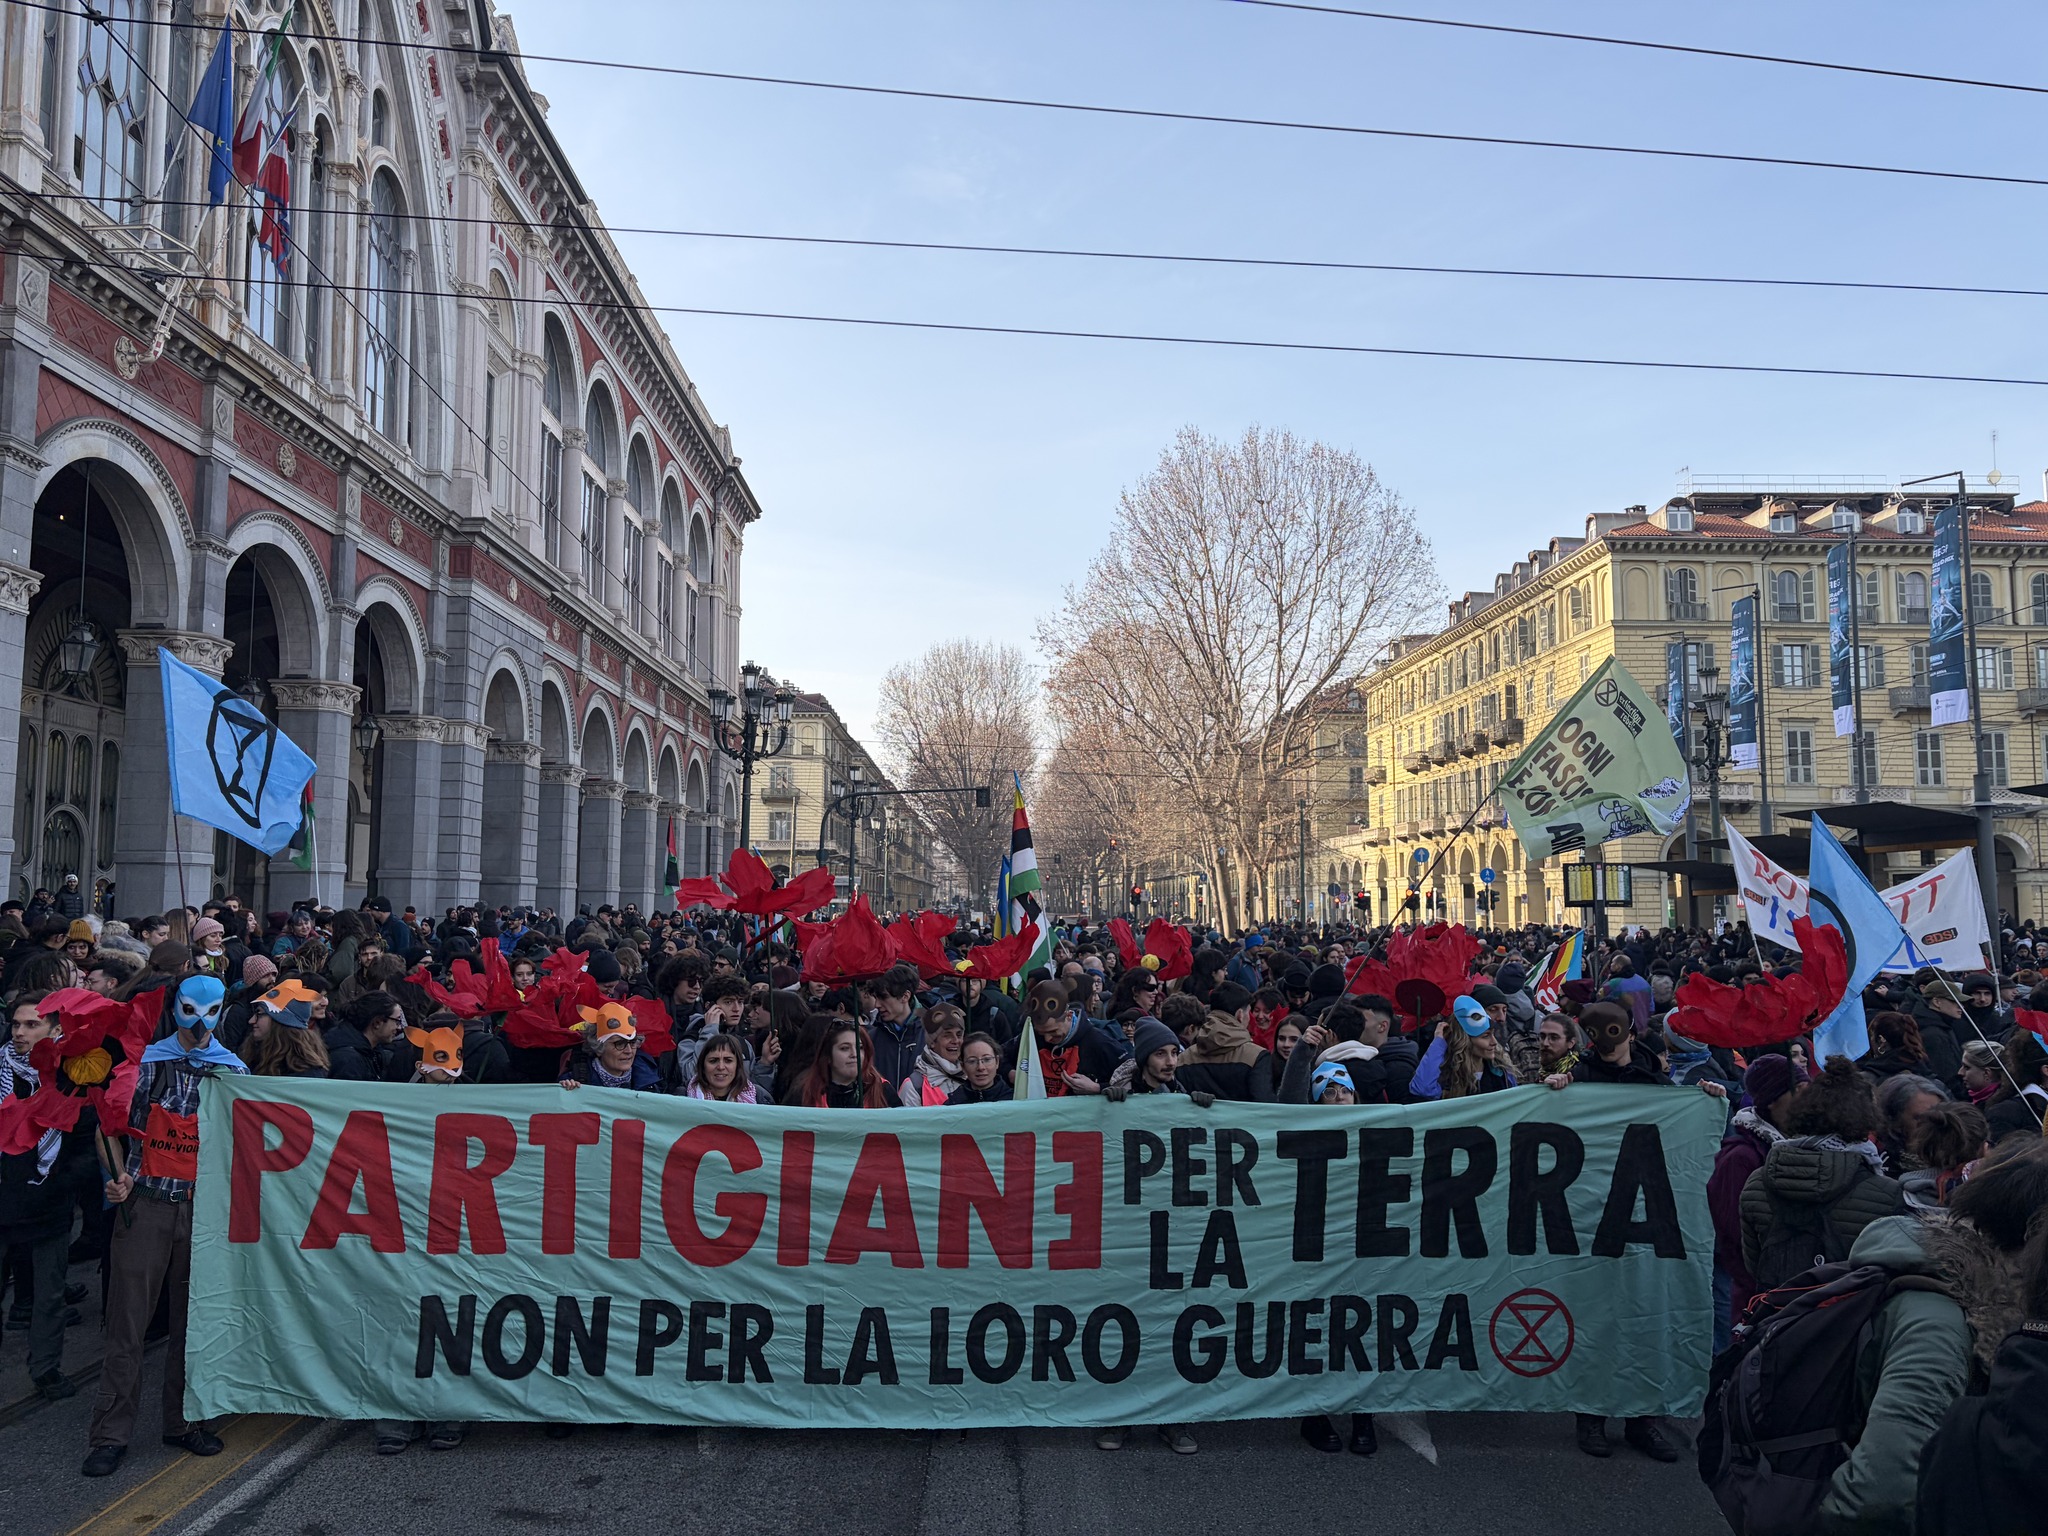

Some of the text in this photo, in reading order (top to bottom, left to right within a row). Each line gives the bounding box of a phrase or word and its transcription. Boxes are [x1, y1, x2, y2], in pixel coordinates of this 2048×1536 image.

[1557, 716, 1616, 778] OGNI
[1619, 694, 1642, 724] extinction
[1123, 1127, 1262, 1207] PER
[1277, 1122, 1687, 1263] TERRA
[1149, 1209, 1249, 1290] LA
[414, 1293, 1480, 1386] NON PER LA LORO GUERRA
